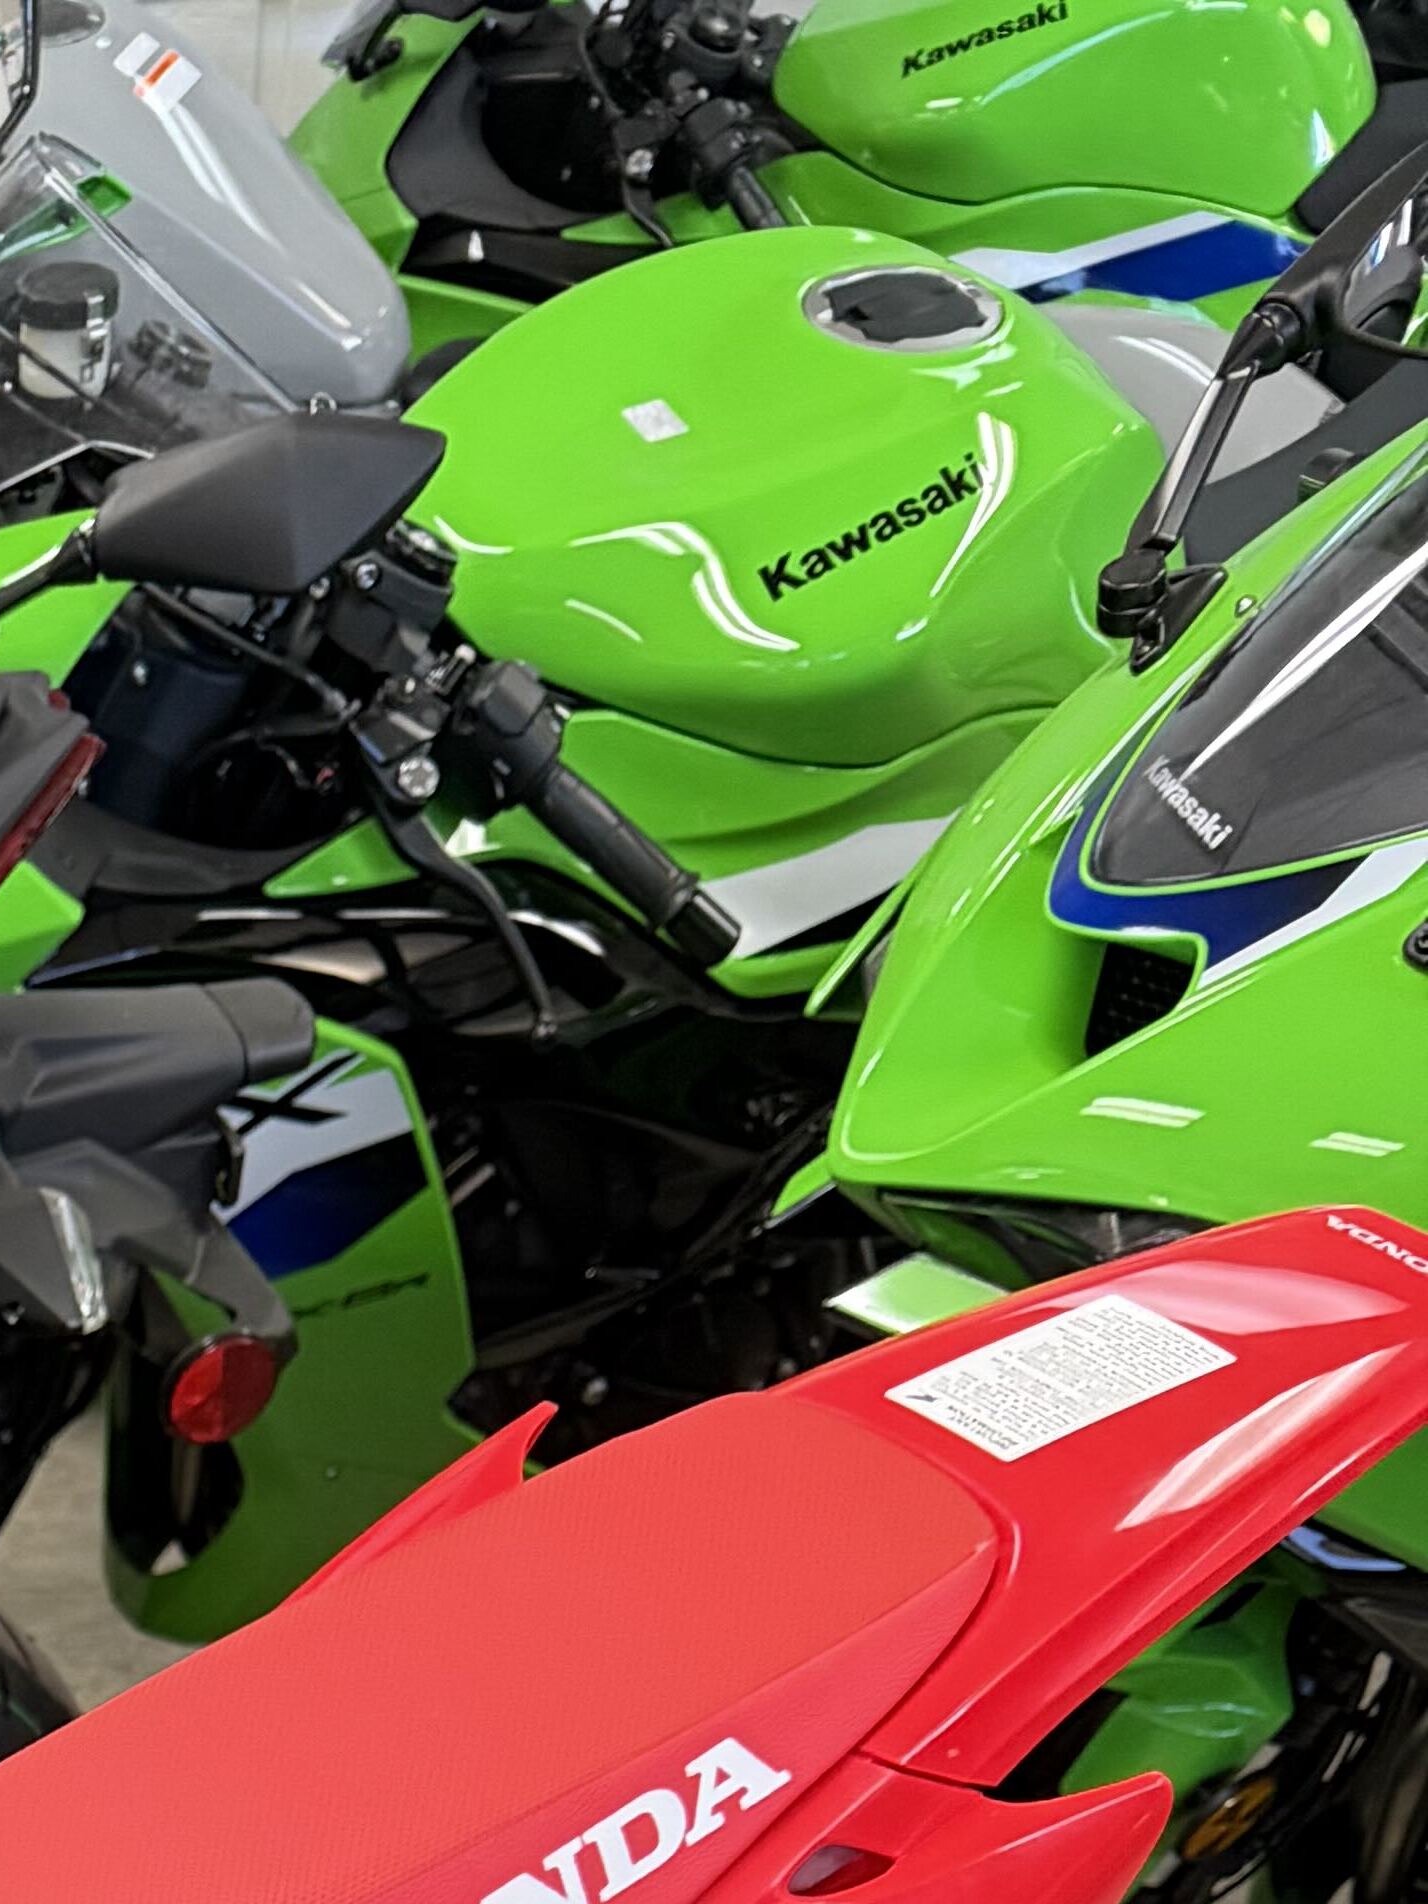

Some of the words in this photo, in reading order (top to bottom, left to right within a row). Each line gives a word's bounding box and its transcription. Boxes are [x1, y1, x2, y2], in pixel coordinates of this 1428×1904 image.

[901, 0, 1069, 79] Kawasaki
[757, 451, 984, 602] Kawasaki
[1143, 754, 1233, 850] Kawasaki
[1327, 1214, 1428, 1275] ONDA
